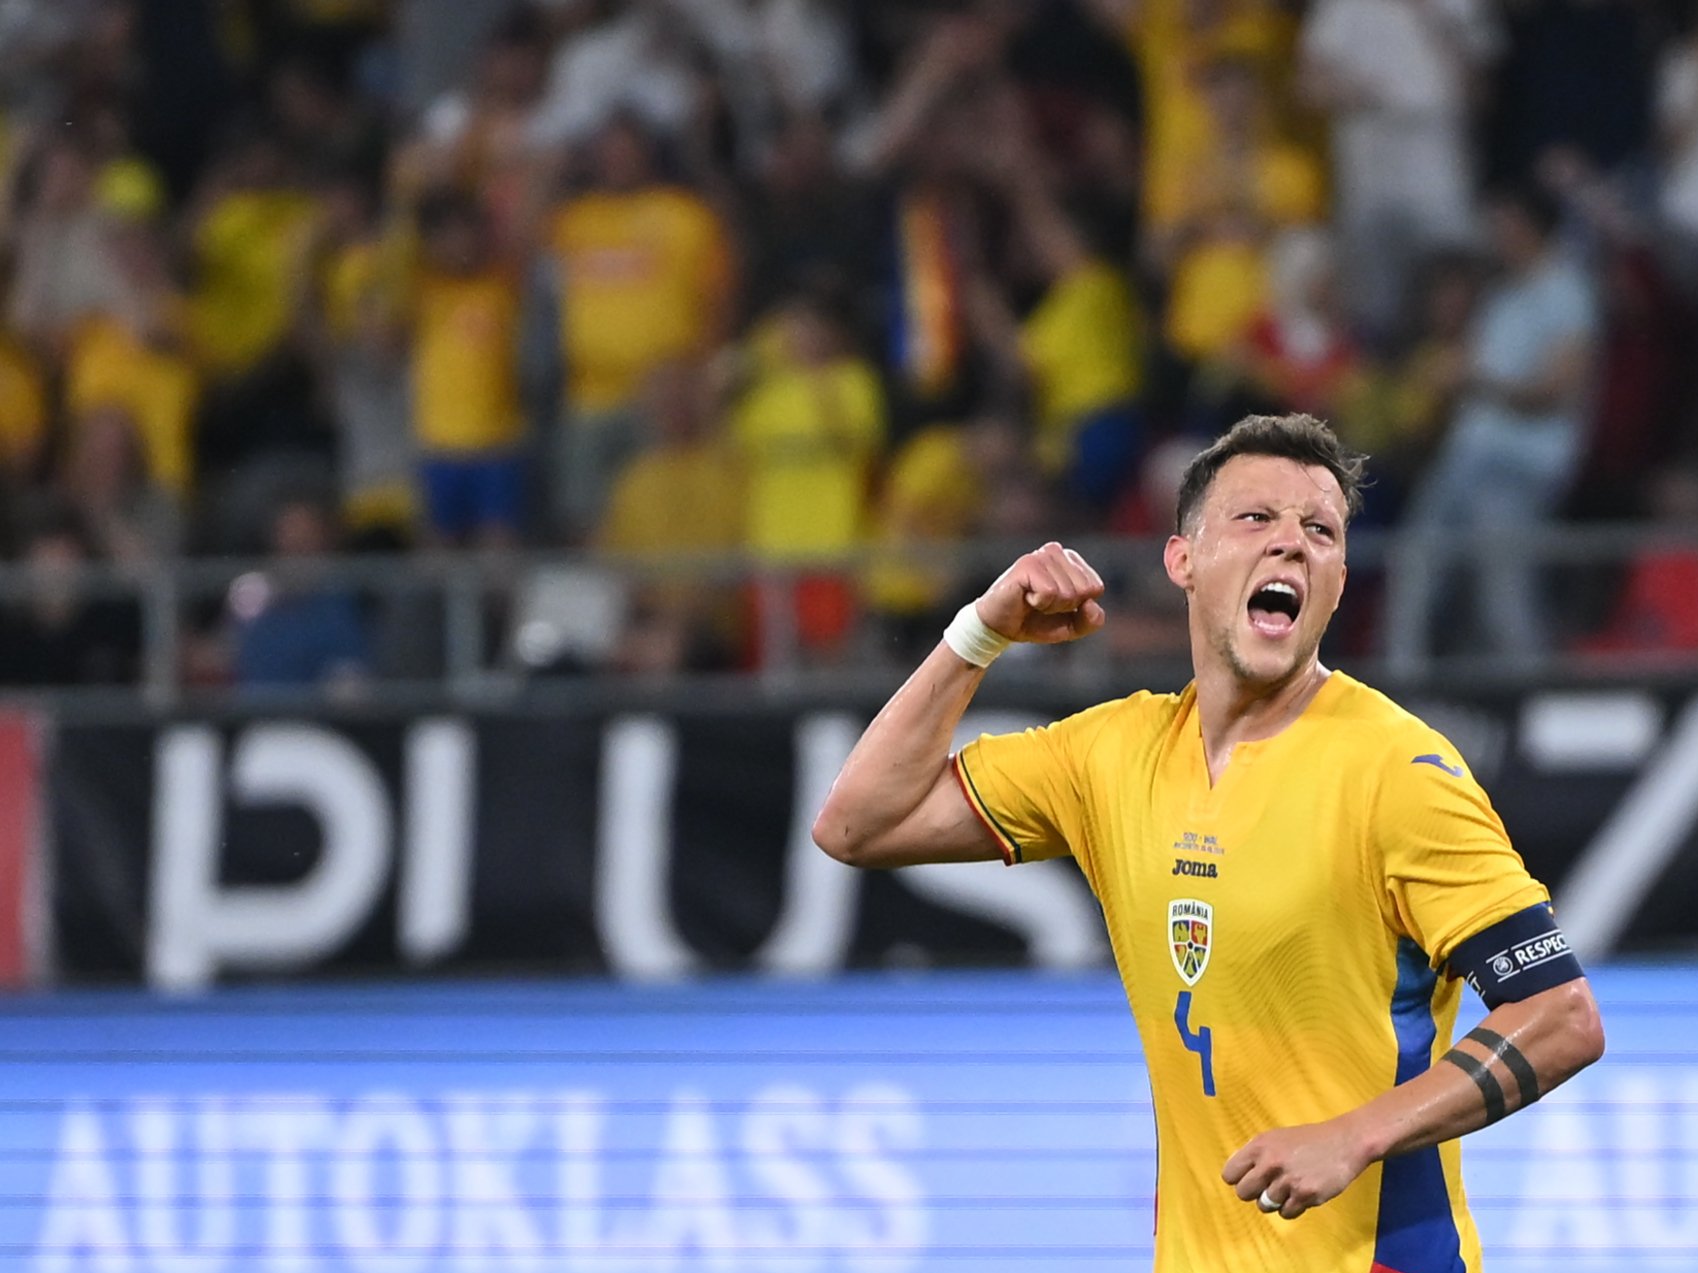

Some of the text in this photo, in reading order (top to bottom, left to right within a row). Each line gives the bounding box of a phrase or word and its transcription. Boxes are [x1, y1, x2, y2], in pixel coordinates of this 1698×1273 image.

[1172, 858, 1218, 879] Joma
[1172, 901, 1209, 920] ROMÂNIA
[1174, 991, 1216, 1097] 4
